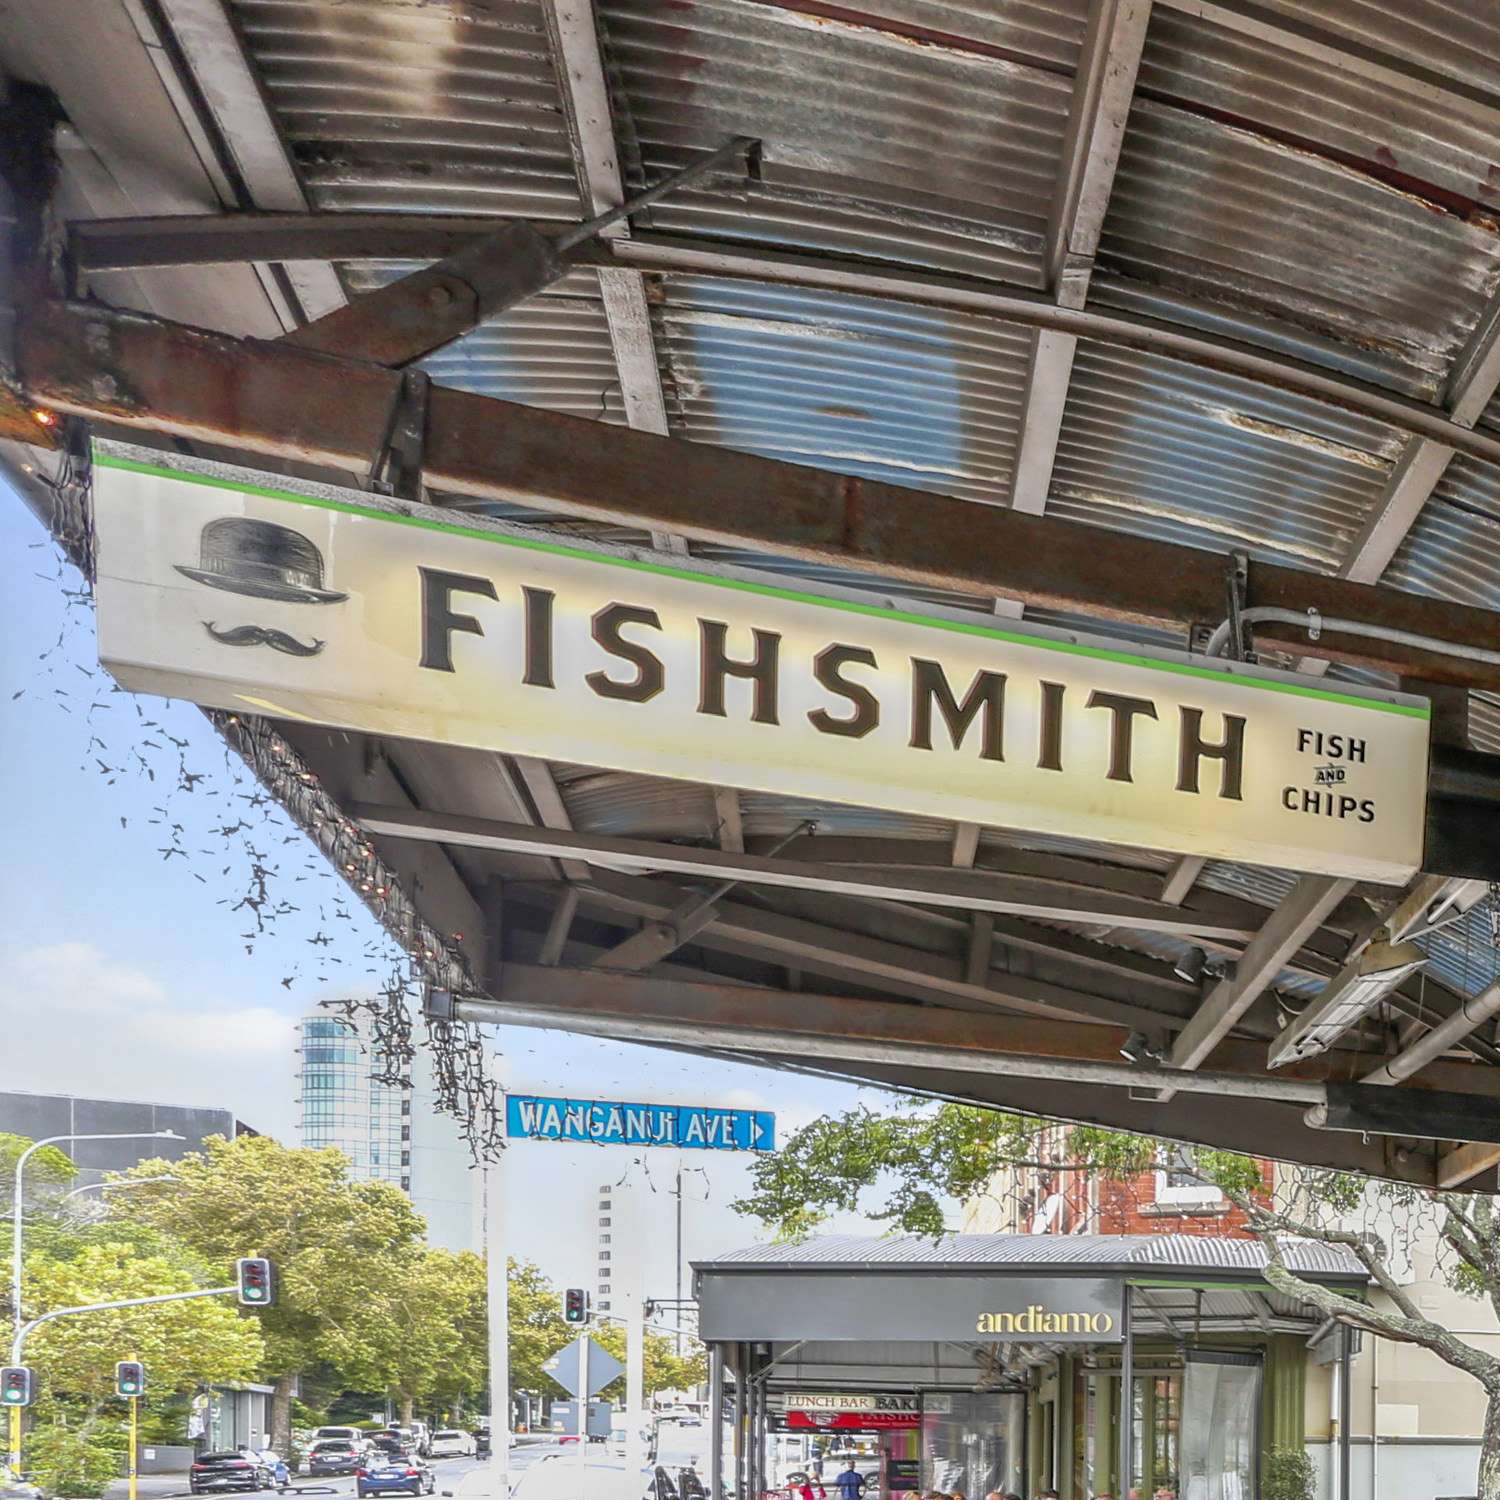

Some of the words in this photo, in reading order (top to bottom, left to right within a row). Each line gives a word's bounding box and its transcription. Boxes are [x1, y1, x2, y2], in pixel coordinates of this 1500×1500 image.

[419, 565, 1247, 801] FISHSMITH
[1297, 728, 1366, 762] FISH
[1315, 769, 1345, 781] AND
[1282, 786, 1375, 822] CHIPS
[519, 1101, 674, 1141] WANGANUI
[687, 1114, 738, 1145] AVE
[976, 1305, 1113, 1333] andiamo
[788, 1396, 834, 1408] LUNCH
[840, 1397, 869, 1408] BAR
